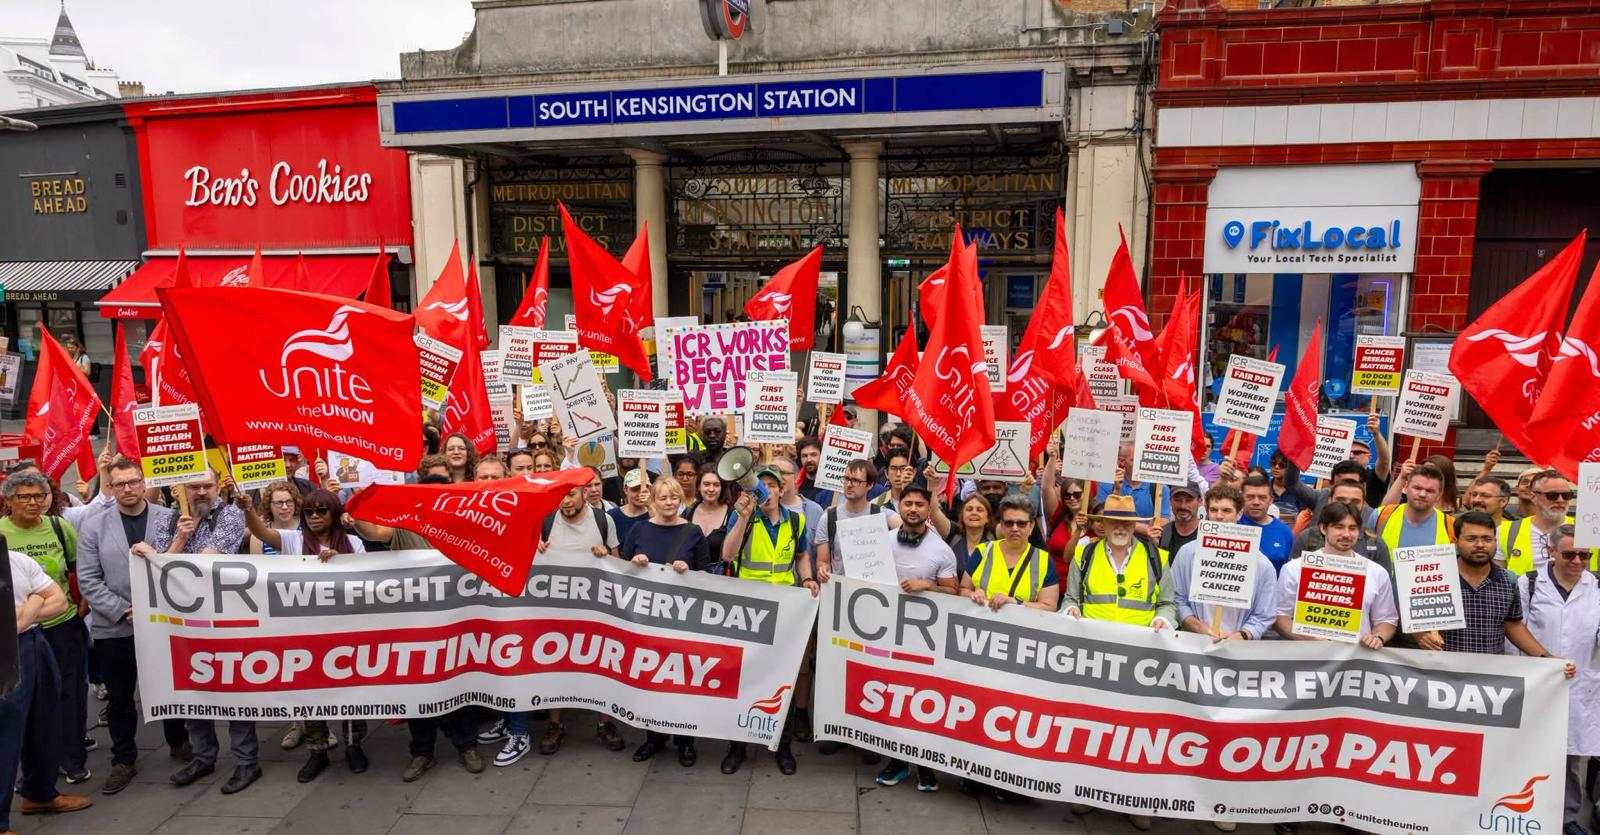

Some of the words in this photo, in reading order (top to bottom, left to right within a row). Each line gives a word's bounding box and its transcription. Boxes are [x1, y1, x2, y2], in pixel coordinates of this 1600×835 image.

[539, 99, 608, 120] SOUTH
[615, 92, 753, 116] KENSINGTON
[763, 87, 856, 110] STATION
[31, 179, 86, 197] BREAD
[184, 165, 260, 208] Ben's
[269, 158, 372, 207] Cookies
[721, 176, 789, 194] SOUTH
[892, 173, 1056, 193] METROPOLITAN
[493, 183, 627, 201] METROPOLITAN
[33, 195, 87, 214] AHEAD
[683, 198, 830, 225] KENSINGTON
[1249, 219, 1401, 250] FixLocal
[1247, 255, 1272, 263] Your
[1275, 254, 1306, 263] Local
[1309, 254, 1335, 263] Tech
[1337, 253, 1398, 264] Specialist
[5, 292, 31, 301] BREAD
[32, 292, 58, 301] AHEAD
[673, 333, 711, 360] ICR
[715, 327, 788, 356] WORKS
[1359, 336, 1374, 346] ICR
[1364, 348, 1396, 357] CANCER
[551, 361, 564, 373] CEO
[565, 356, 579, 367] PAY
[1230, 355, 1248, 368] ICR
[1361, 356, 1396, 364] RESEARH
[675, 354, 786, 386] BECAUSE
[1359, 362, 1396, 372] MATTERS,
[748, 371, 764, 381] ICR
[1233, 370, 1254, 381] FAIR
[1254, 374, 1272, 385] PAY
[1406, 370, 1423, 381] ICR
[760, 385, 784, 393] FIRST
[1241, 381, 1260, 392] FOR
[1376, 379, 1392, 387] PAY
[1410, 382, 1428, 393] FAIR
[1430, 385, 1447, 396] PAY
[565, 393, 596, 409] SCIENTIST
[618, 390, 634, 400] ICR
[679, 382, 728, 410] WE
[759, 394, 784, 402] CLASS
[1227, 388, 1270, 404] WORKERS
[1418, 393, 1436, 402] FOR
[625, 403, 642, 411] FAIR
[642, 403, 657, 411] PAY
[754, 404, 788, 412] SCIENCE
[1225, 398, 1266, 413] FIGHTING
[1405, 399, 1446, 412] WORKERS
[134, 410, 156, 422] ICR
[634, 412, 649, 420] FOR
[753, 413, 787, 421] SECOND
[1139, 409, 1157, 419] ICR
[1226, 408, 1261, 421] CANCER
[1403, 408, 1443, 421] FIGHTING
[147, 423, 188, 434] CANCER
[623, 421, 660, 429] WORKERS
[751, 422, 772, 431] RATE
[772, 423, 788, 431] PAY
[1152, 424, 1177, 433] FIRST
[1404, 417, 1438, 429] CANCER
[146, 432, 192, 444] RESEARH
[624, 429, 659, 439] FIGHTING
[1150, 433, 1177, 443] CLASS
[146, 441, 195, 454] MATTERS,
[626, 438, 657, 447] CANCER
[1144, 442, 1180, 453] SCIENCE
[152, 457, 167, 466] SO
[168, 454, 195, 464] DOES
[1142, 452, 1179, 463] SECOND
[152, 465, 175, 475] OUR
[175, 463, 195, 473] PAY
[1140, 461, 1161, 472] RATE
[1161, 464, 1180, 475] PAY
[1198, 521, 1219, 534] ICR
[1204, 537, 1227, 548] FAIR
[1228, 540, 1248, 550] PAY
[1215, 550, 1236, 560] FOR
[1303, 553, 1324, 566] ICR
[1395, 550, 1415, 561] ICR
[1200, 559, 1248, 572] WORKERS
[1414, 563, 1441, 573] FIRST
[1199, 570, 1246, 583] FIGHTING
[1311, 571, 1354, 584] CANCER
[1414, 574, 1443, 584] CLASS
[146, 559, 260, 614] ICR
[1201, 581, 1241, 593] CANCER
[1307, 581, 1356, 595] RESEARH
[1410, 584, 1450, 595] SCIENCE
[275, 580, 337, 607] WE
[344, 575, 451, 606] FIGHT
[456, 573, 592, 600] CACER
[597, 581, 699, 621] EVERY
[700, 602, 770, 633] DAY
[1304, 590, 1355, 606] MATTERS,
[1411, 595, 1451, 607] SECOND
[832, 581, 939, 652] ICR
[1306, 605, 1322, 616] SO
[1323, 608, 1351, 619] DOES
[1411, 608, 1435, 618] RATE
[1435, 606, 1455, 617] PAY
[1304, 615, 1327, 626] OUR
[1327, 617, 1349, 628] PAY
[189, 648, 314, 685] STOP
[322, 632, 523, 679] CUTTING
[531, 631, 627, 675] OUR
[628, 647, 722, 690] PAY.
[953, 624, 1010, 660] WE
[1016, 637, 1128, 682] FIGHT
[1133, 659, 1288, 700] CANCER
[1294, 669, 1419, 705] EVERY
[1426, 679, 1515, 716] DAY
[151, 704, 186, 718] UNITE
[187, 705, 236, 718] FIGHTING
[238, 705, 260, 718] FOR
[260, 706, 292, 719] JOBS,
[292, 705, 314, 717] PAY
[314, 705, 339, 717] AND
[340, 703, 407, 716] CONDITIONS
[418, 693, 516, 716] UNITETHEUNION.ORG
[859, 679, 977, 731] STOP
[982, 705, 1210, 767] CUTTING
[1218, 732, 1330, 774] OUR
[1335, 732, 1457, 786] PAY.
[824, 723, 854, 739] UNITE
[854, 729, 898, 754] FIGHTING
[899, 743, 919, 758] FOR
[920, 747, 949, 768] JOBS,
[950, 755, 970, 771] PAY
[970, 761, 992, 778] AND
[994, 769, 1062, 795] CONDITIONS
[1074, 784, 1195, 812] UNITETHEUNION.ORG
[1479, 812, 1541, 835] unite
